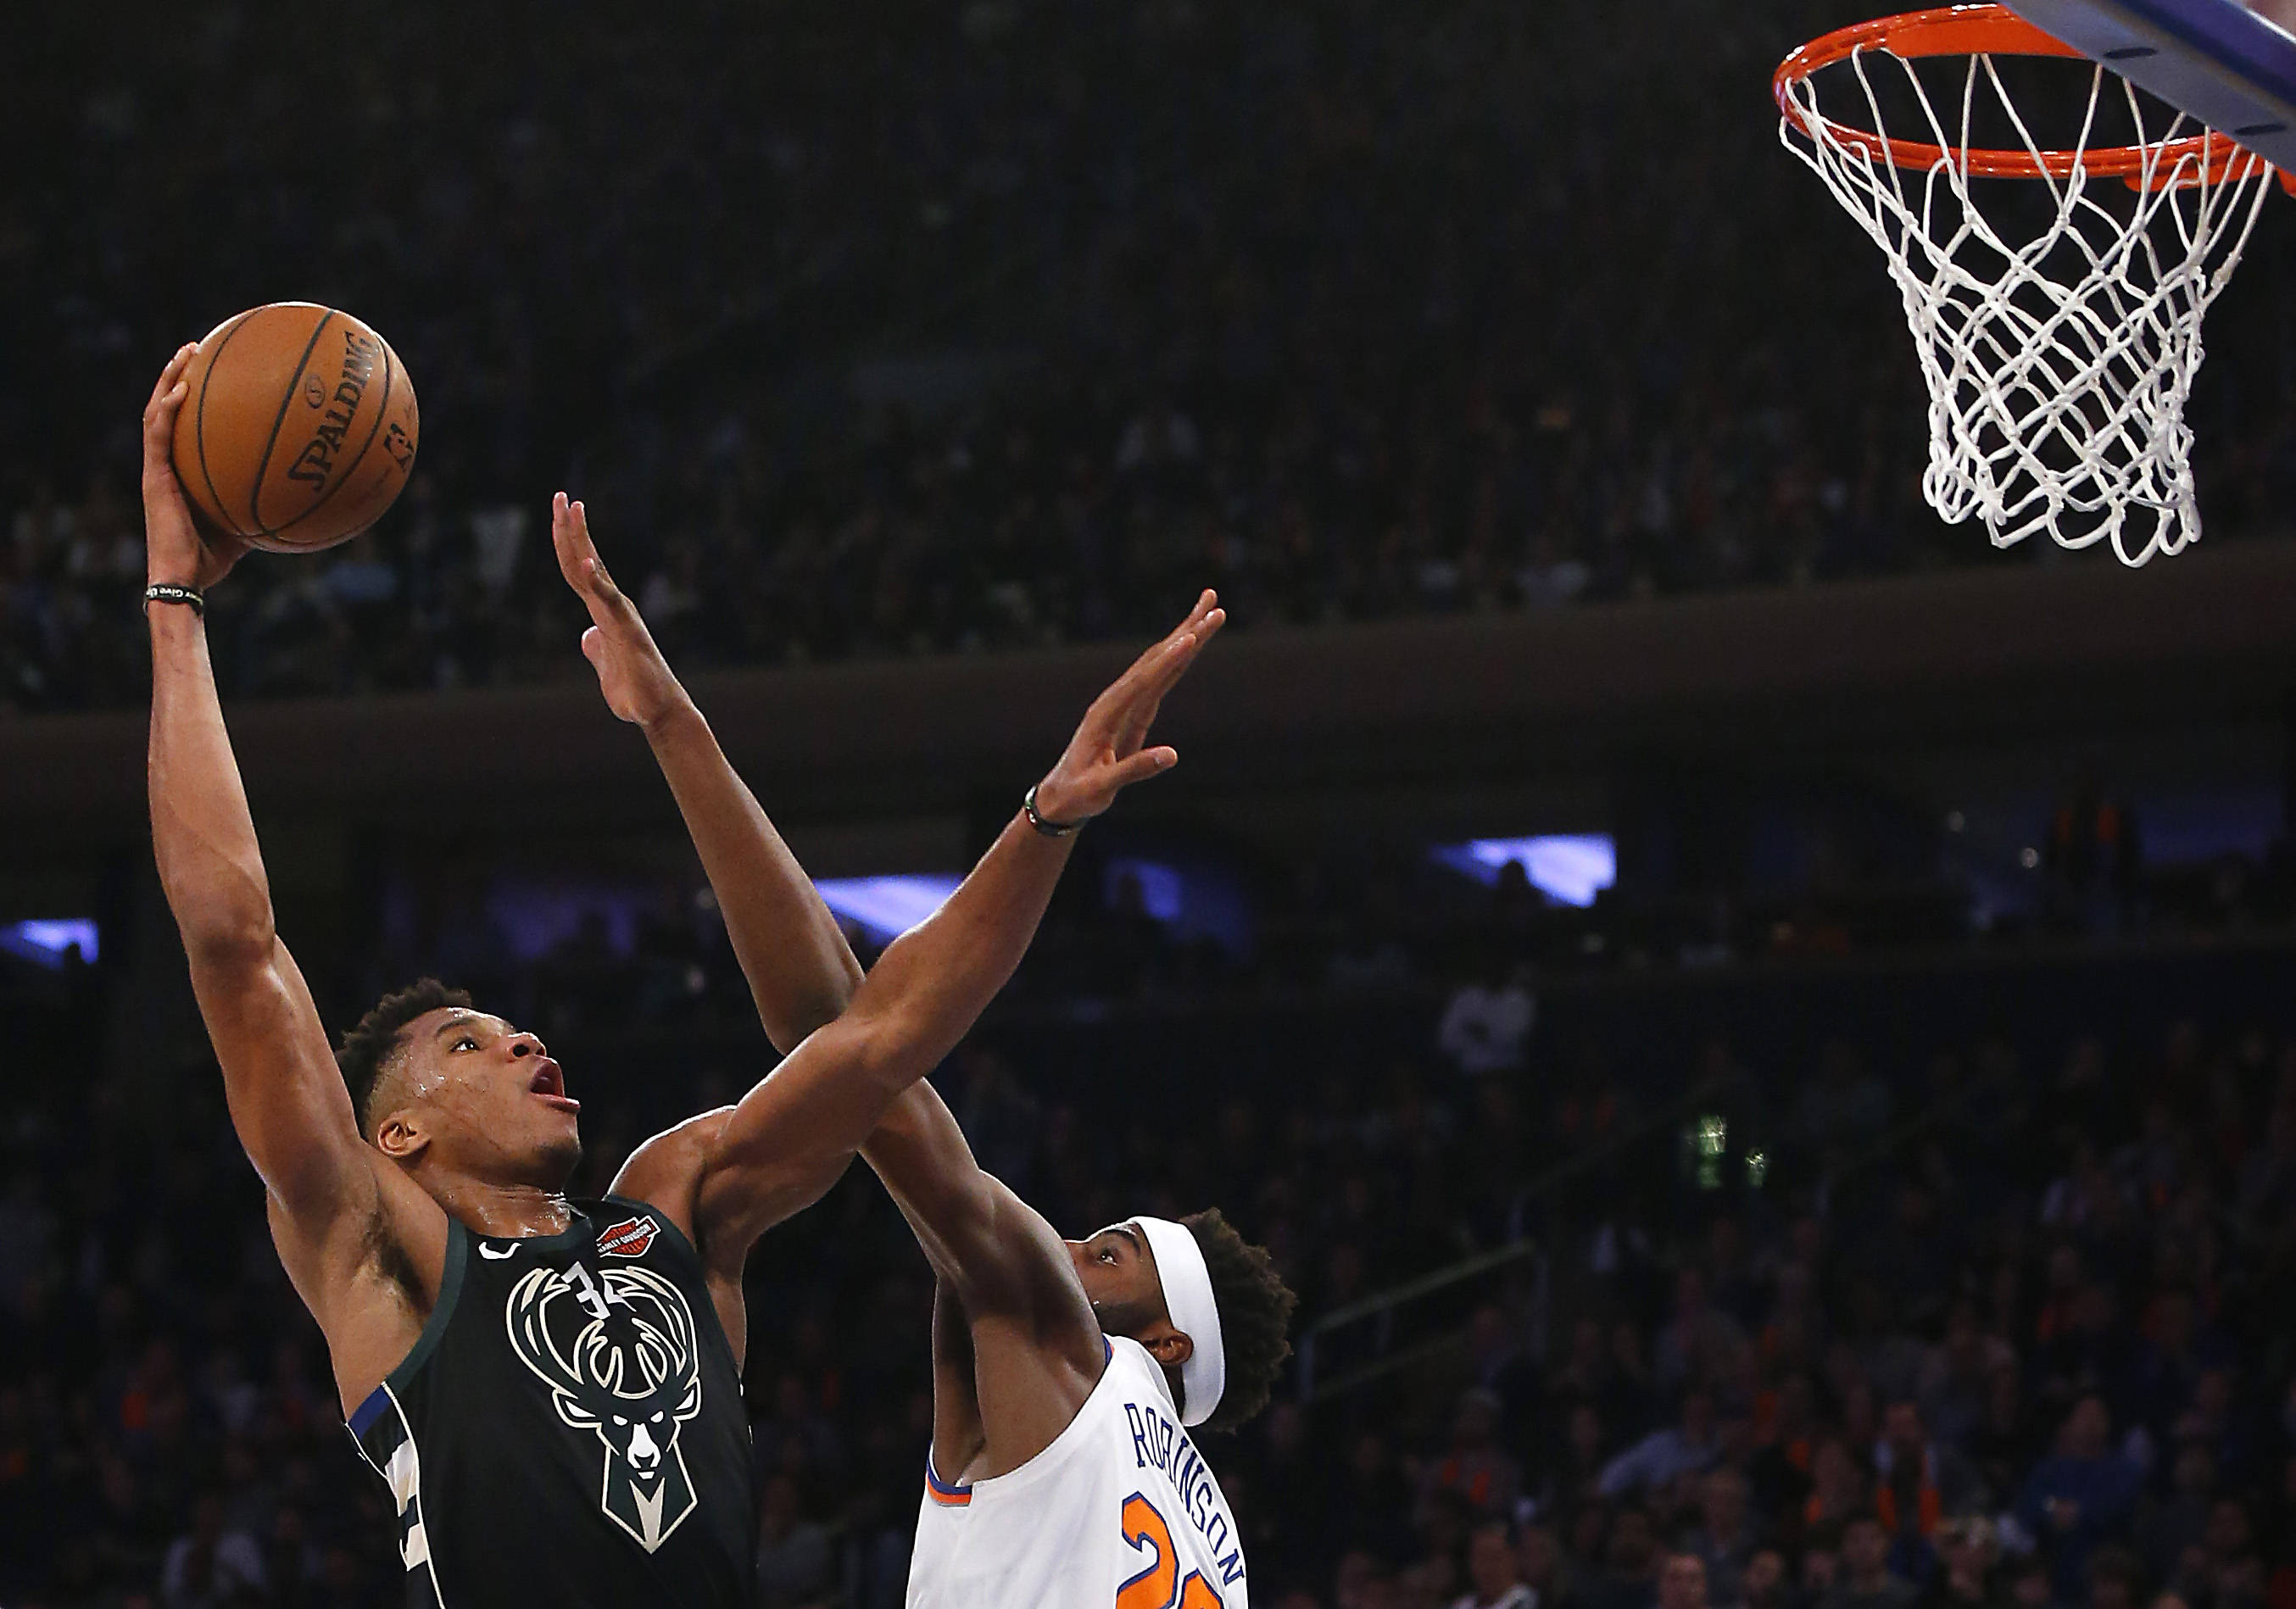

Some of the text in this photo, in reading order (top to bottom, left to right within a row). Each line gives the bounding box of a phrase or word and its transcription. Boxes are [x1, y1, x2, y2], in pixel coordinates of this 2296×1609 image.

[287, 331, 375, 493] SPALDING
[1116, 1490, 1226, 1609] 2
[1124, 1402, 1245, 1587] ROBINSON
